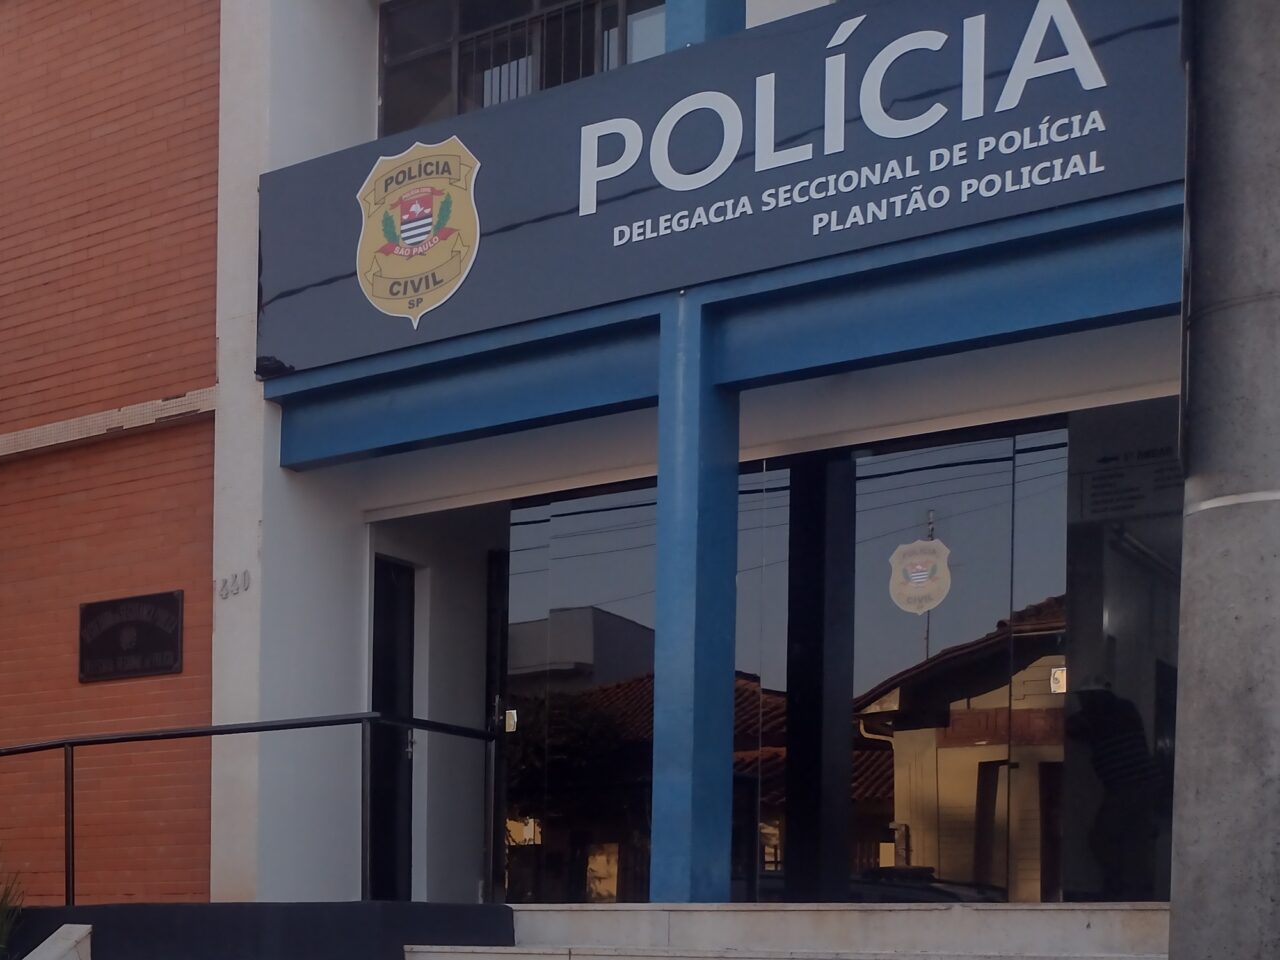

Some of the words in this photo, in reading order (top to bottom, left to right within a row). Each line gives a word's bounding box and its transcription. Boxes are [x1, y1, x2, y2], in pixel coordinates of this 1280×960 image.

[579, 0, 1107, 216] POLÍCIA
[384, 159, 452, 193] POLÍCIA
[613, 196, 753, 247] DELEGACIA
[761, 156, 919, 211] SECCIONAL
[929, 142, 967, 172] DE
[978, 110, 1106, 161] POLÍCIA
[812, 185, 950, 235] PLANTÃO
[961, 151, 1105, 202] POLICIAL
[389, 272, 444, 297] CIVIL
[408, 297, 424, 309] SP
